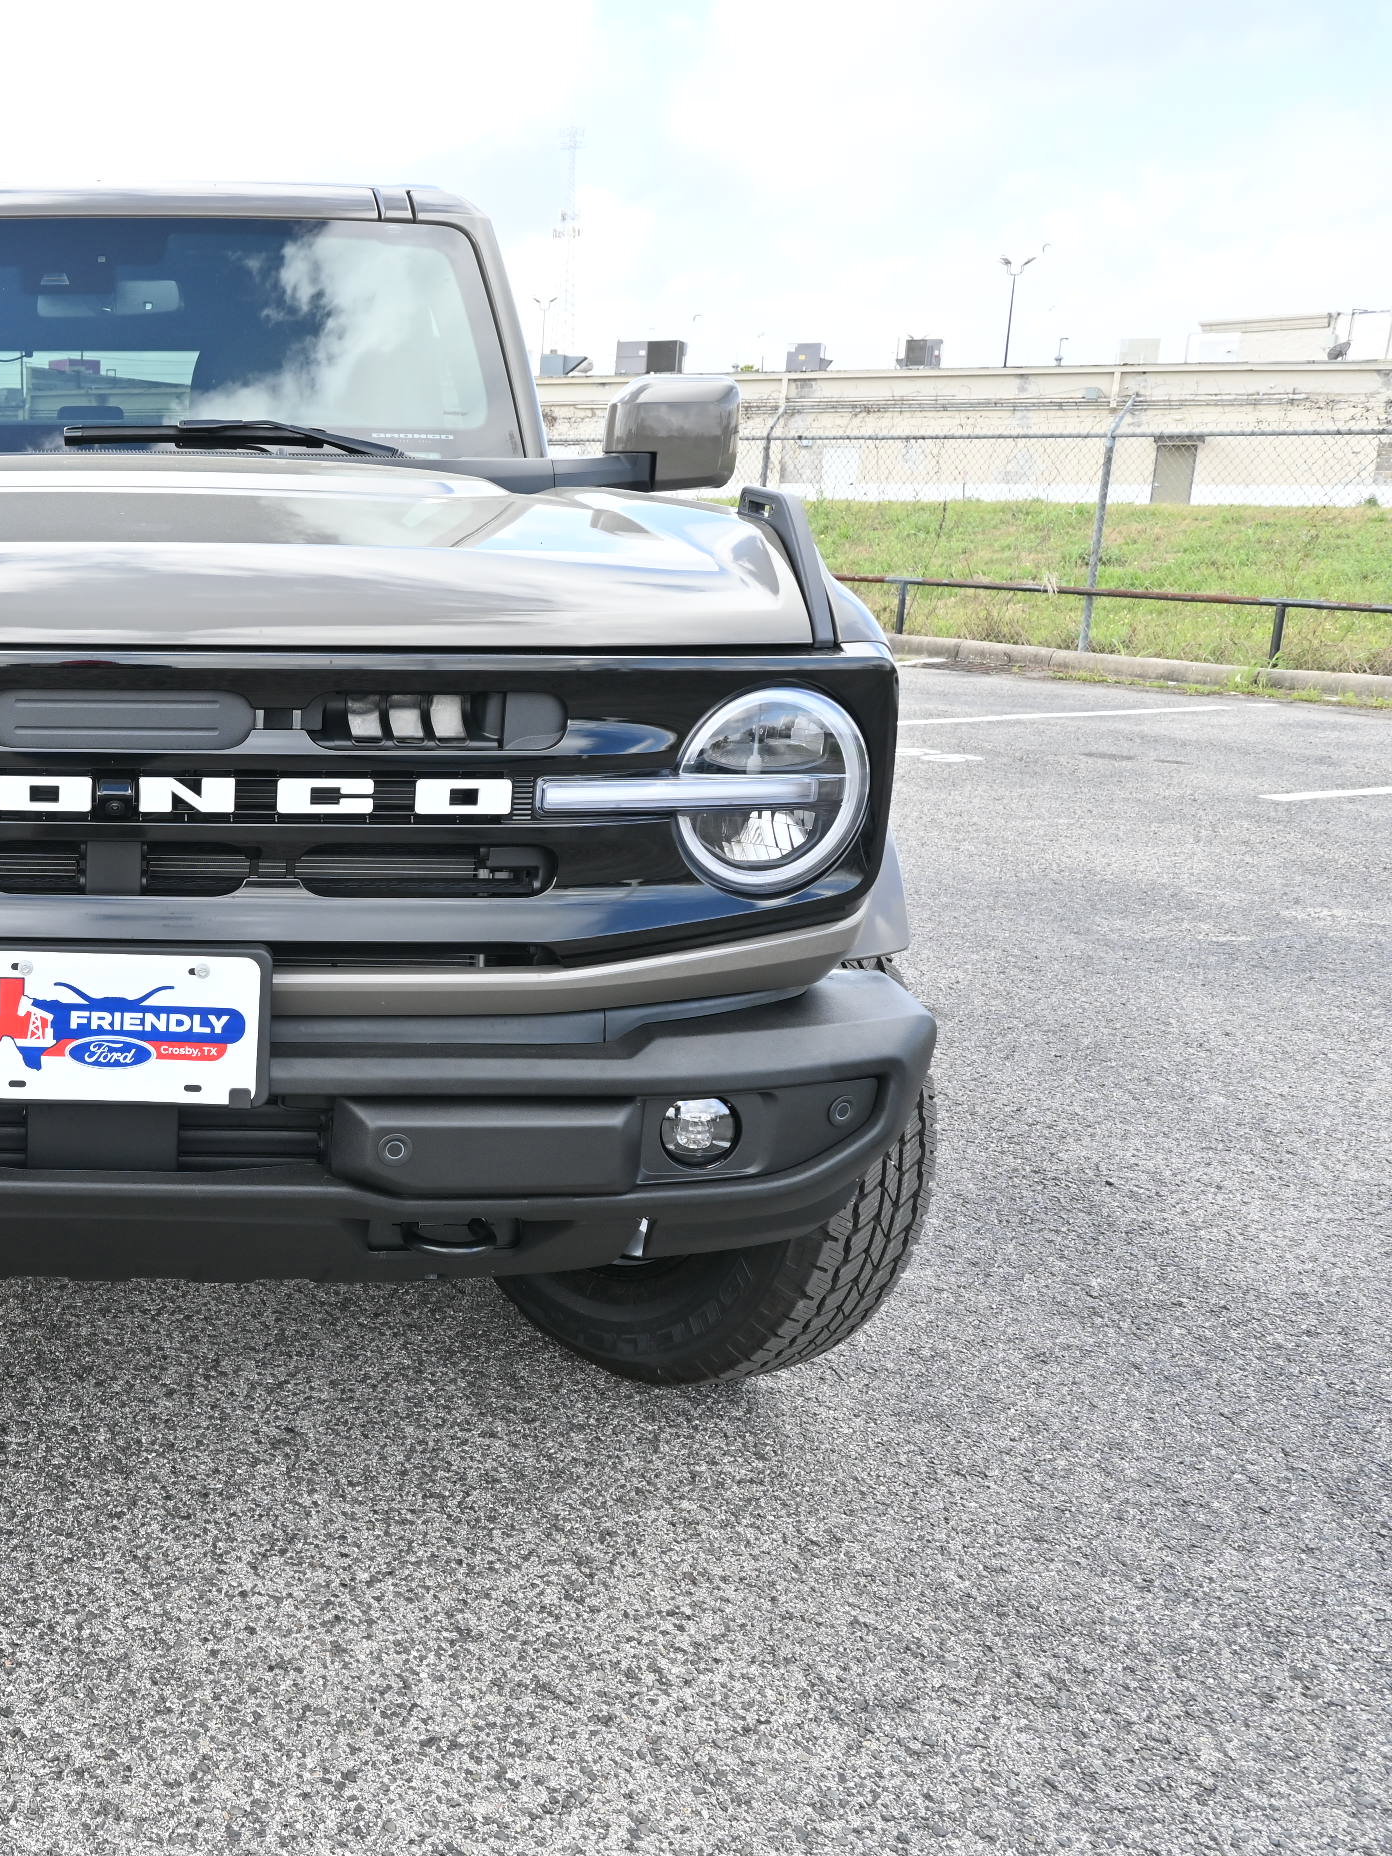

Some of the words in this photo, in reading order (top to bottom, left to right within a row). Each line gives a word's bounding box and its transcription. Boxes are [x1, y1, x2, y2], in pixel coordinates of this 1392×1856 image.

[69, 1010, 231, 1034] FRIENDLY
[84, 1041, 136, 1065] Ford
[160, 1045, 201, 1057] Crosby,
[202, 1046, 218, 1056] TX
